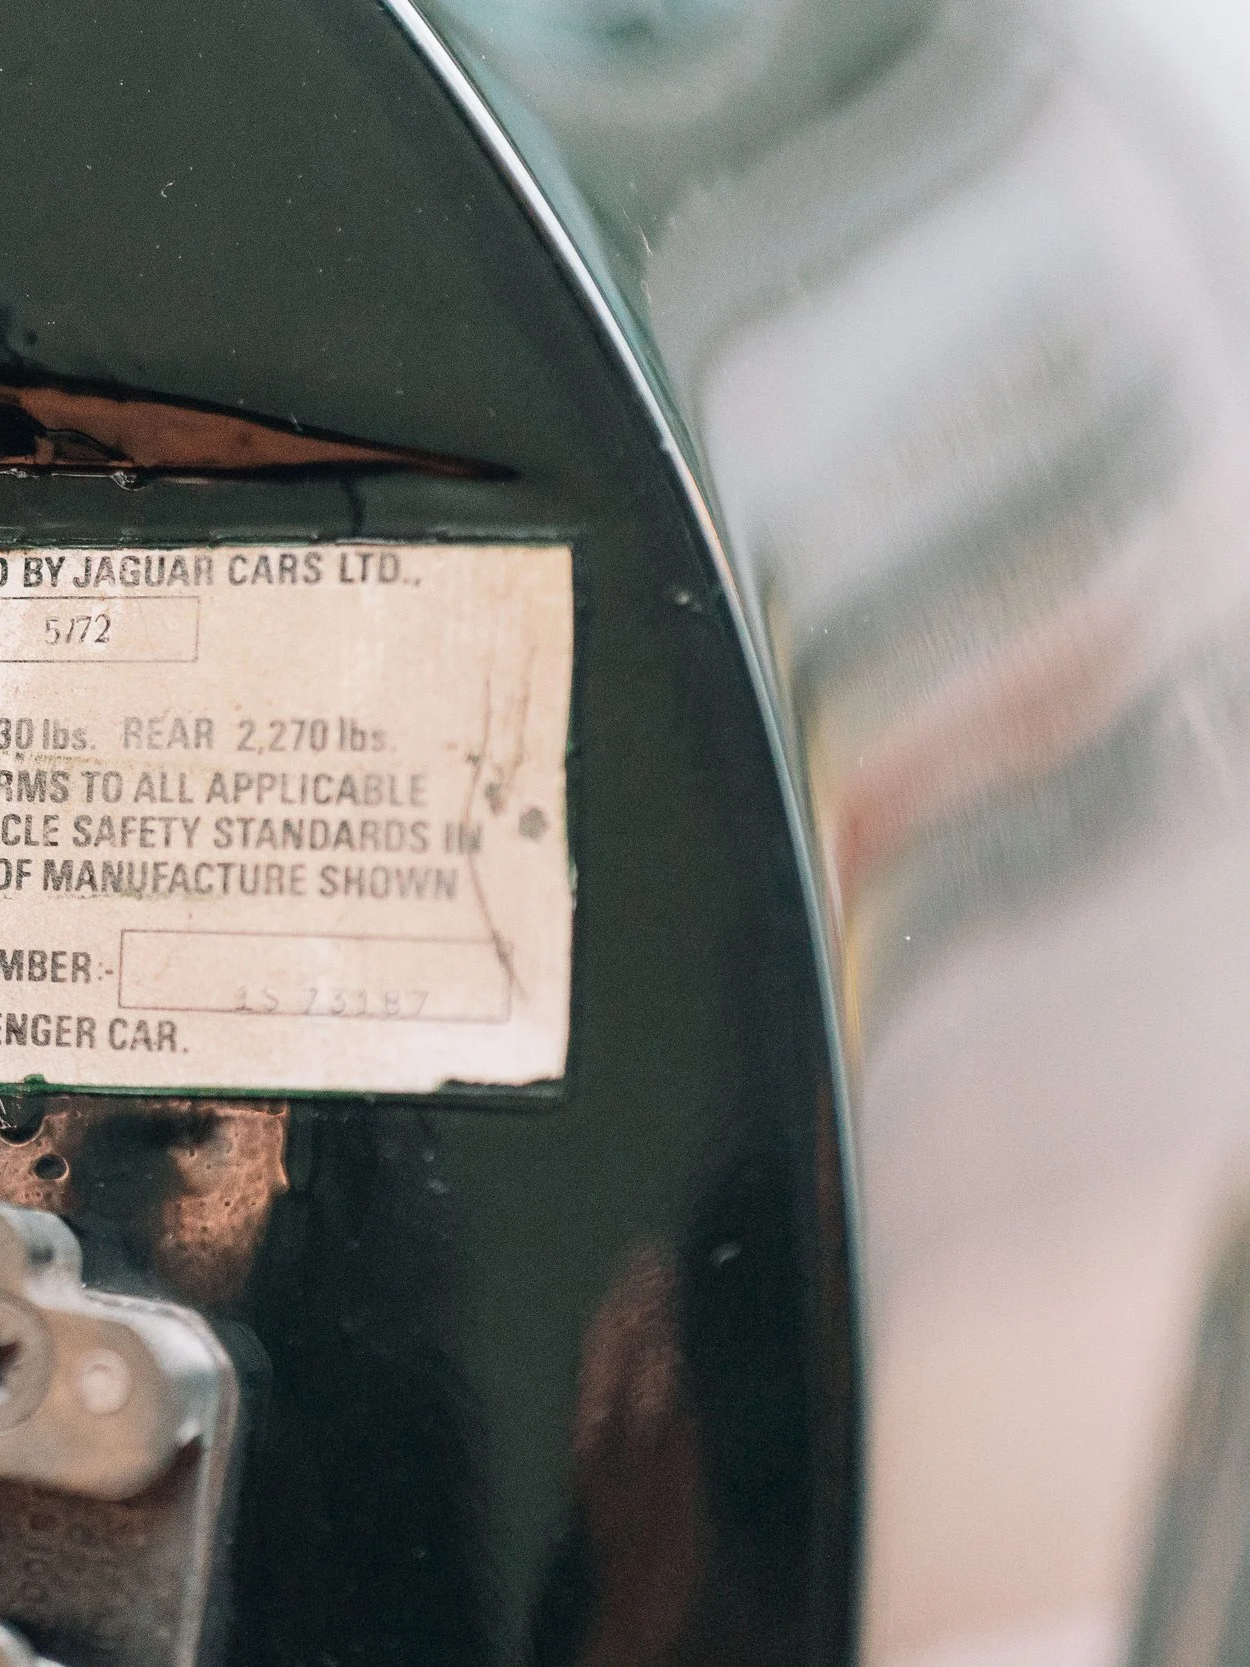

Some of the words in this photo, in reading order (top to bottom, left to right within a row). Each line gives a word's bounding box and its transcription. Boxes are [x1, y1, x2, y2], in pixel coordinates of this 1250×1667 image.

[23, 557, 65, 587] BY
[73, 554, 214, 588] JAGUAR
[228, 554, 322, 586] CARS
[44, 613, 111, 645] 5/72
[43, 720, 96, 750] lbs.
[123, 717, 215, 750] REAR
[237, 718, 329, 756] 2,270
[339, 718, 396, 752] lbs.
[81, 772, 122, 803] TO
[134, 772, 194, 804] ALL
[207, 772, 427, 807] APPLICABLE
[72, 815, 200, 850] SAFETY
[213, 819, 429, 853] STANDARDS
[43, 859, 306, 897] MANUFACTURE
[319, 865, 459, 900] SHOWN
[108, 1018, 188, 1054] CAR.
